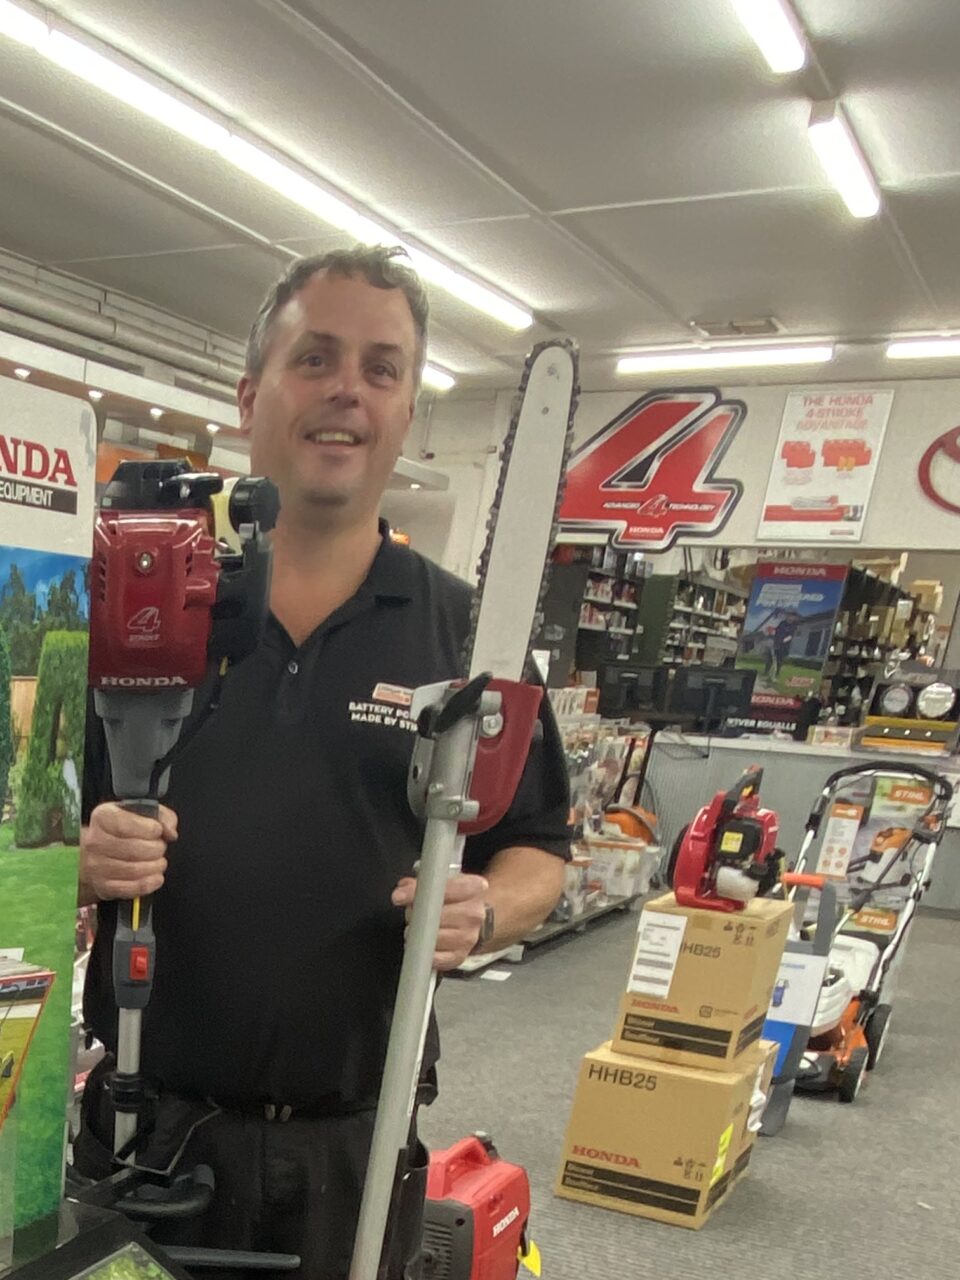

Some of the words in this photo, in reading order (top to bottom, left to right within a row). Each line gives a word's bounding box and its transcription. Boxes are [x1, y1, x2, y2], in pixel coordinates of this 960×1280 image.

[829, 394, 873, 406] HONDA
[629, 527, 665, 535] HONDA
[774, 566, 827, 577] HONDA
[101, 676, 187, 687] HONDA
[348, 701, 394, 715] BATTERY
[351, 712, 382, 723] MADE
[384, 716, 397, 726] BY
[895, 789, 925, 800] STIHL
[859, 914, 891, 926] STIHL
[680, 943, 721, 959] HB25
[588, 1063, 658, 1091] HHB25
[572, 1145, 642, 1169] HONDA
[493, 1206, 520, 1238] HONDA
